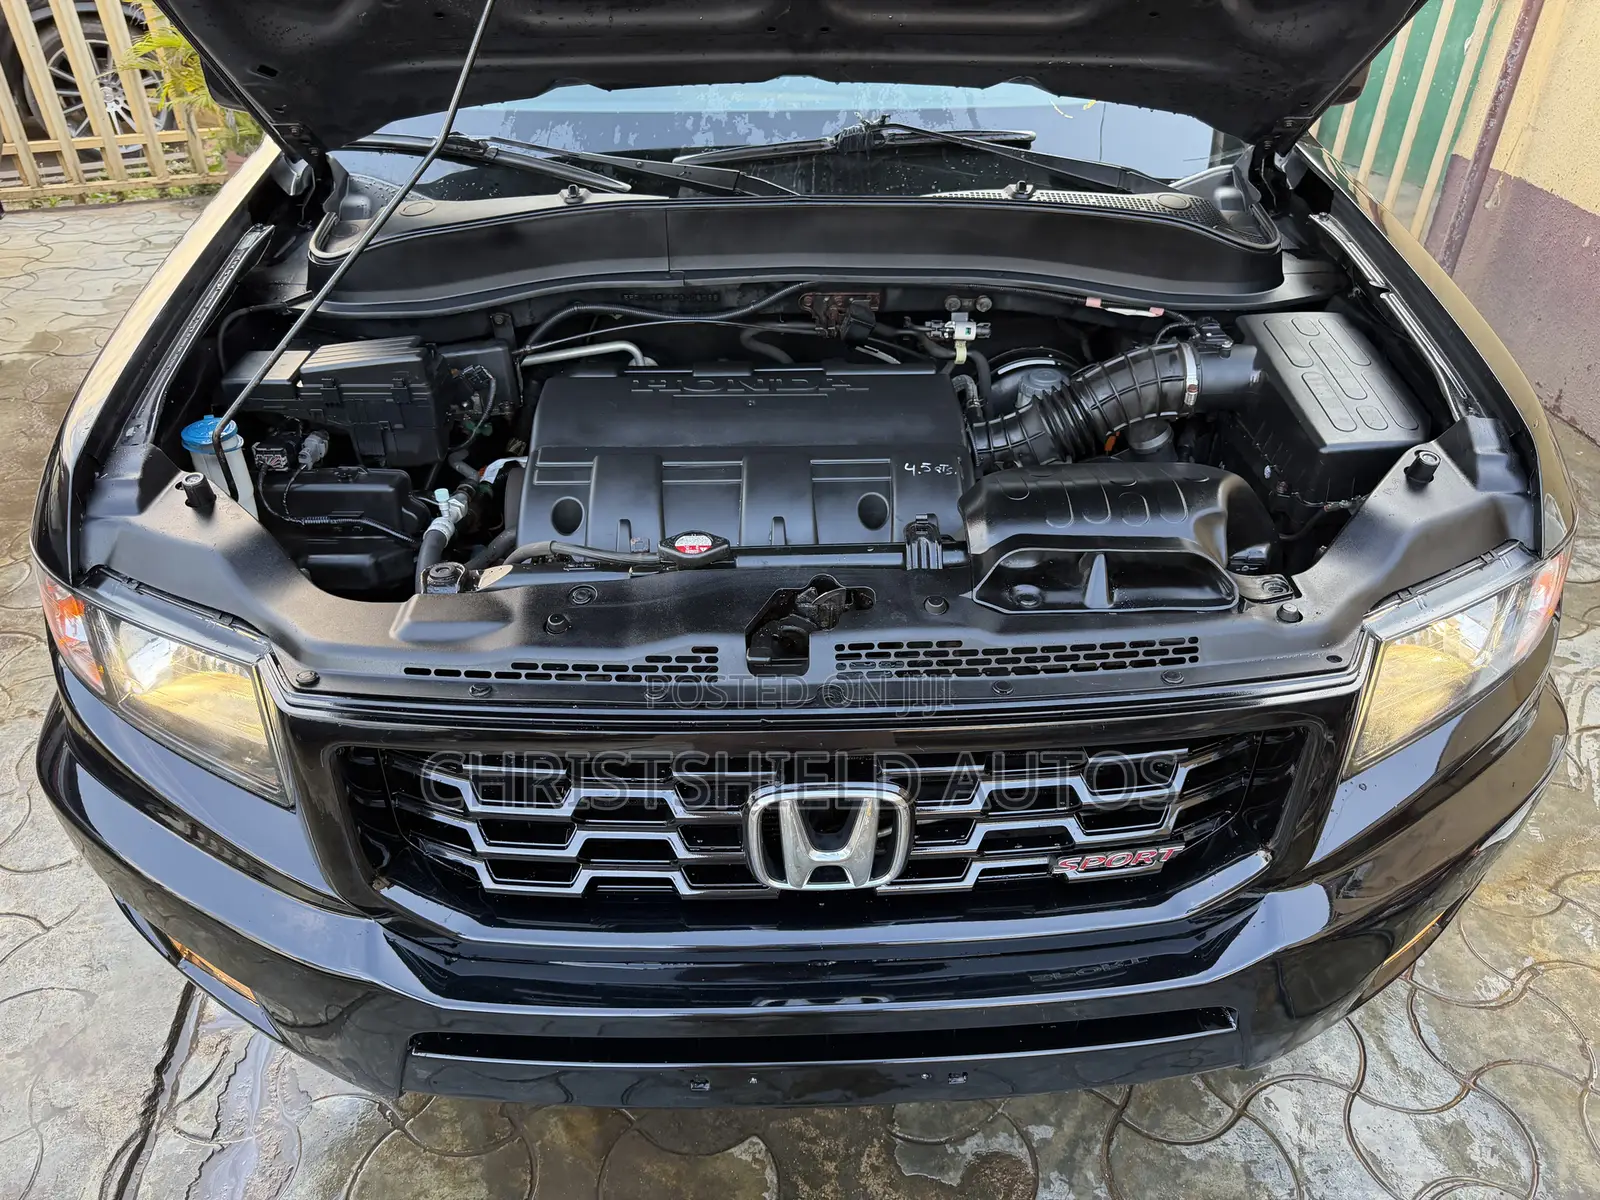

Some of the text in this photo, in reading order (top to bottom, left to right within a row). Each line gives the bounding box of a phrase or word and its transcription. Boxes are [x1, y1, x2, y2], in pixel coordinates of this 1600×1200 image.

[631, 378, 870, 392] HONDA
[904, 462, 932, 477] 4.5
[1052, 845, 1185, 874] SPORT
